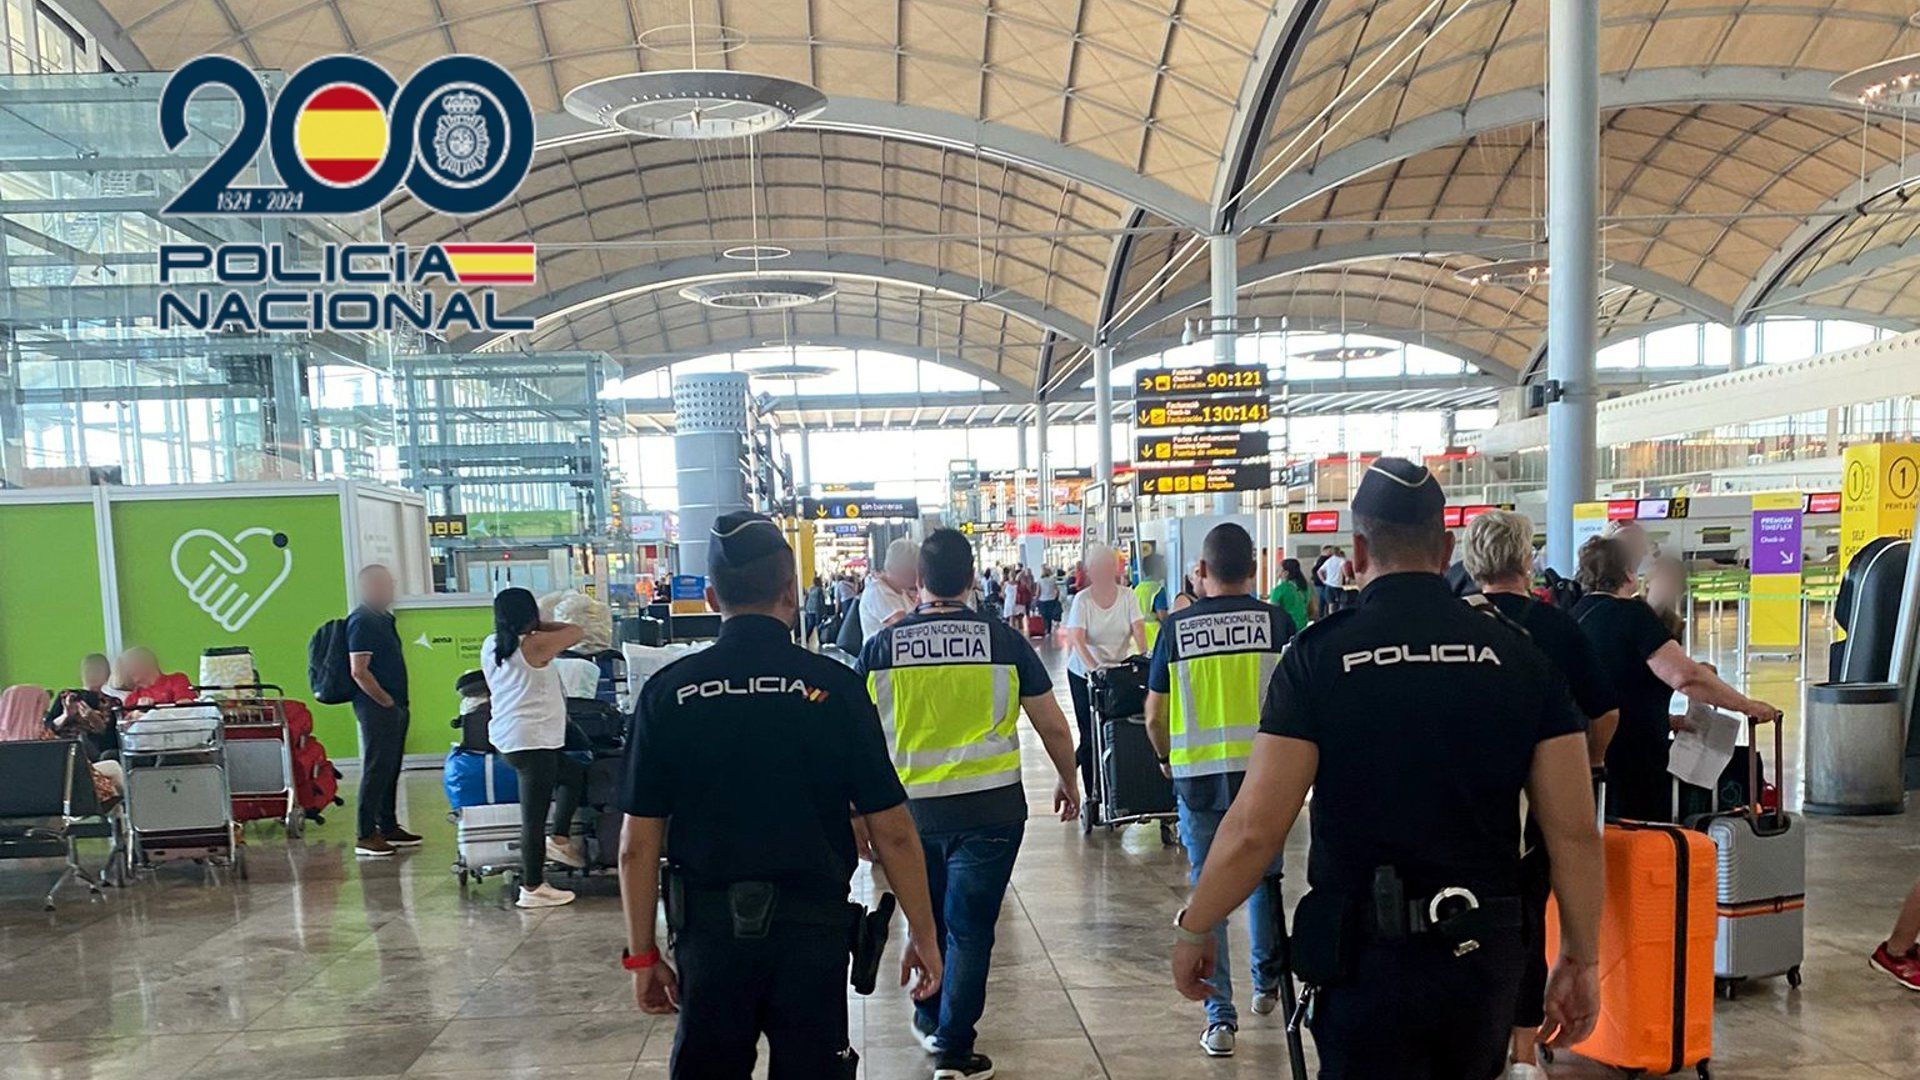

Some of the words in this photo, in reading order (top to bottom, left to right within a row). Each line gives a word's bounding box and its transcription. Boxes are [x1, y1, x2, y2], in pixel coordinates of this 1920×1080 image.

[1207, 371, 1261, 388] 90:121
[1203, 404, 1269, 422] 130:141
[895, 624, 929, 639] CUERPO
[931, 623, 972, 635] NACIONAL
[1180, 617, 1213, 631] CUERPO
[1213, 614, 1253, 626] NACIONAL
[895, 637, 986, 661] POLICIA
[1180, 626, 1267, 652] POLICIA
[1342, 644, 1501, 673] POLICIA
[676, 677, 809, 705] POLICIA
